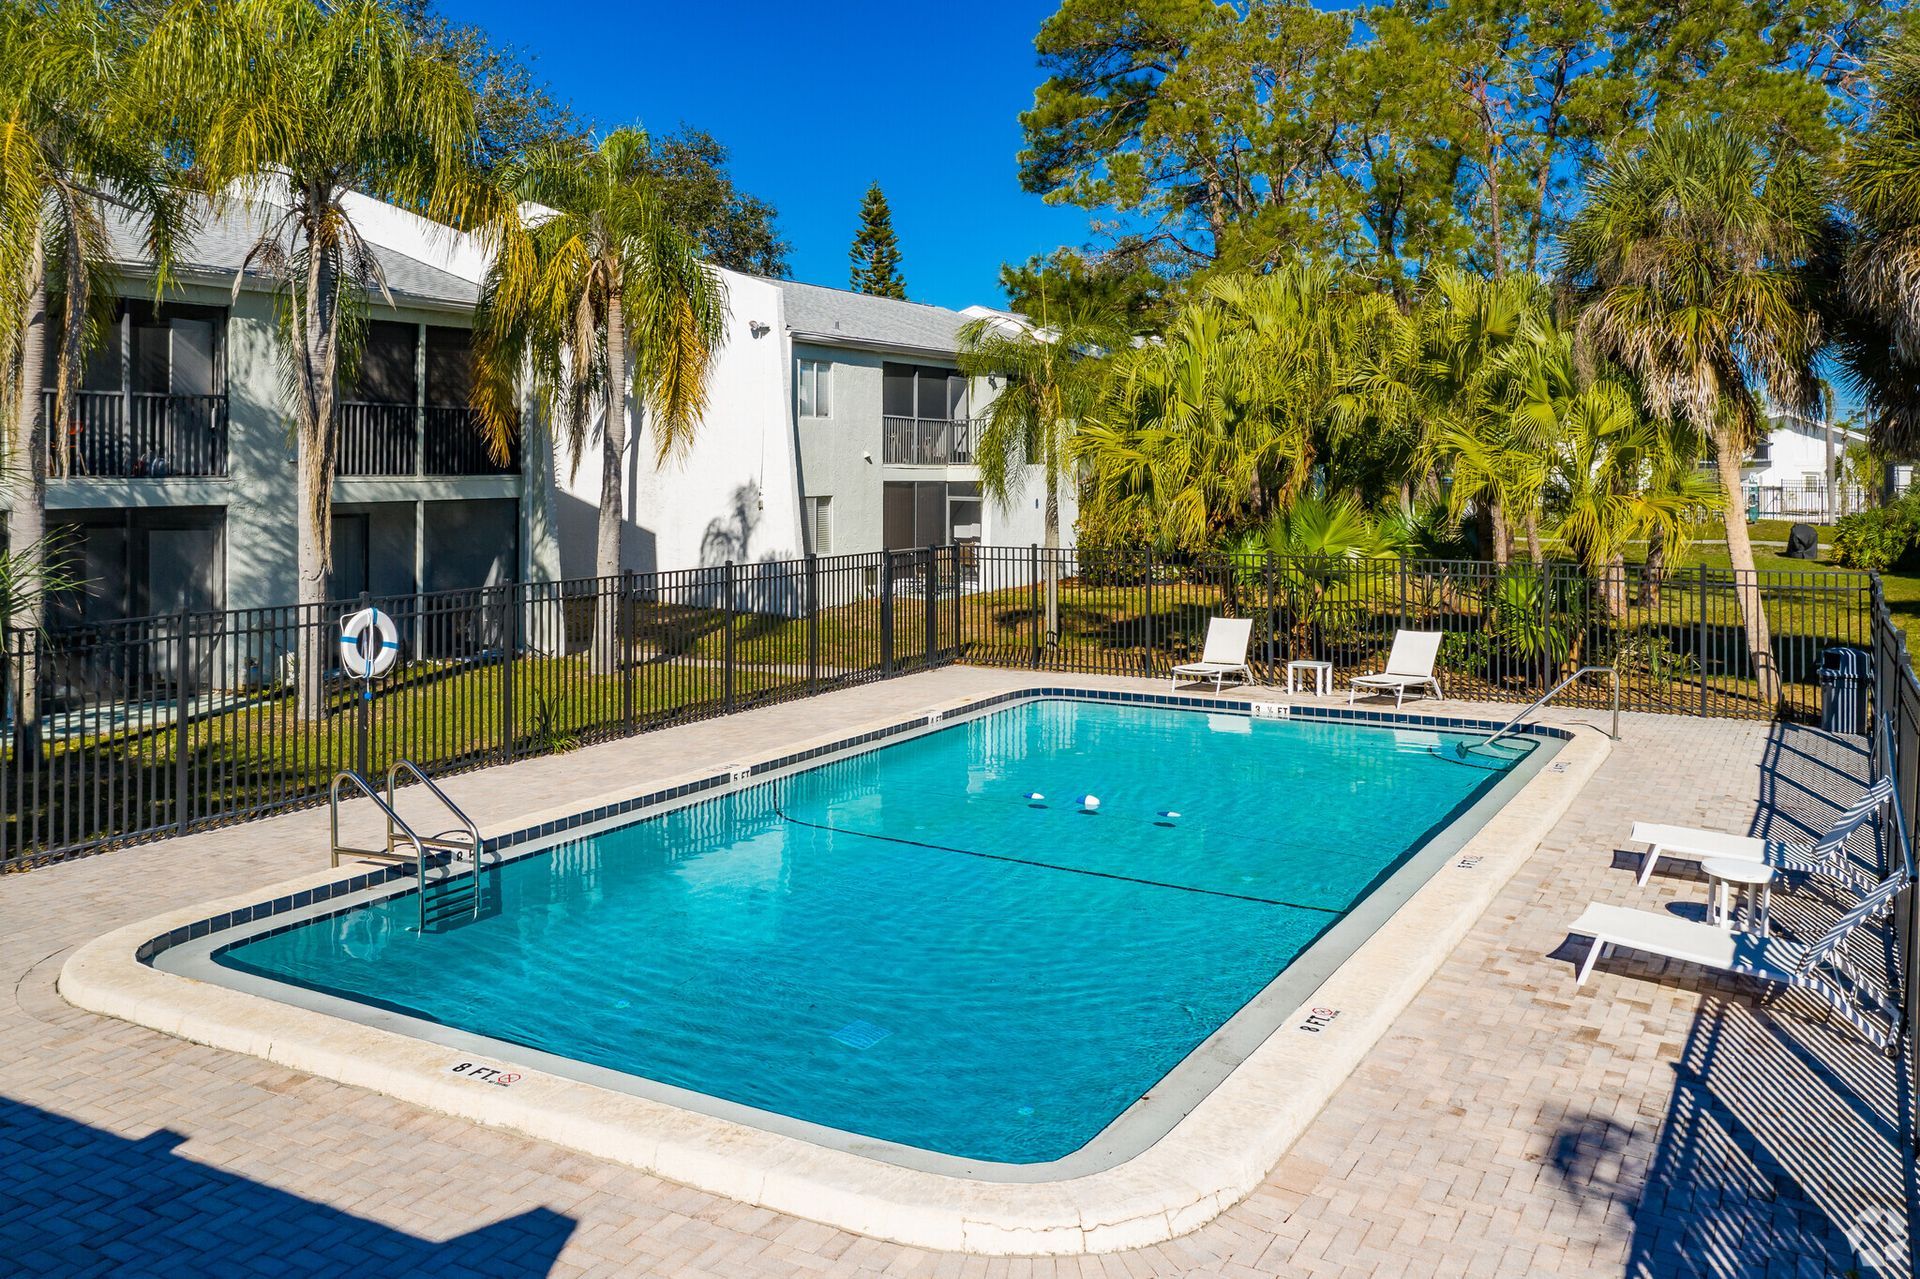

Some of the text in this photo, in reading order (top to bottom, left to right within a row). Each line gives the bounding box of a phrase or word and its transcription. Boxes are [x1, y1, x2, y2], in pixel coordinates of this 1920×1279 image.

[1255, 705, 1261, 713] 3
[1277, 707, 1289, 715] FT
[733, 770, 750, 781] 5 FT
[456, 850, 464, 862] 8
[1299, 1025, 1320, 1033] 8
[452, 1062, 473, 1073] 8
